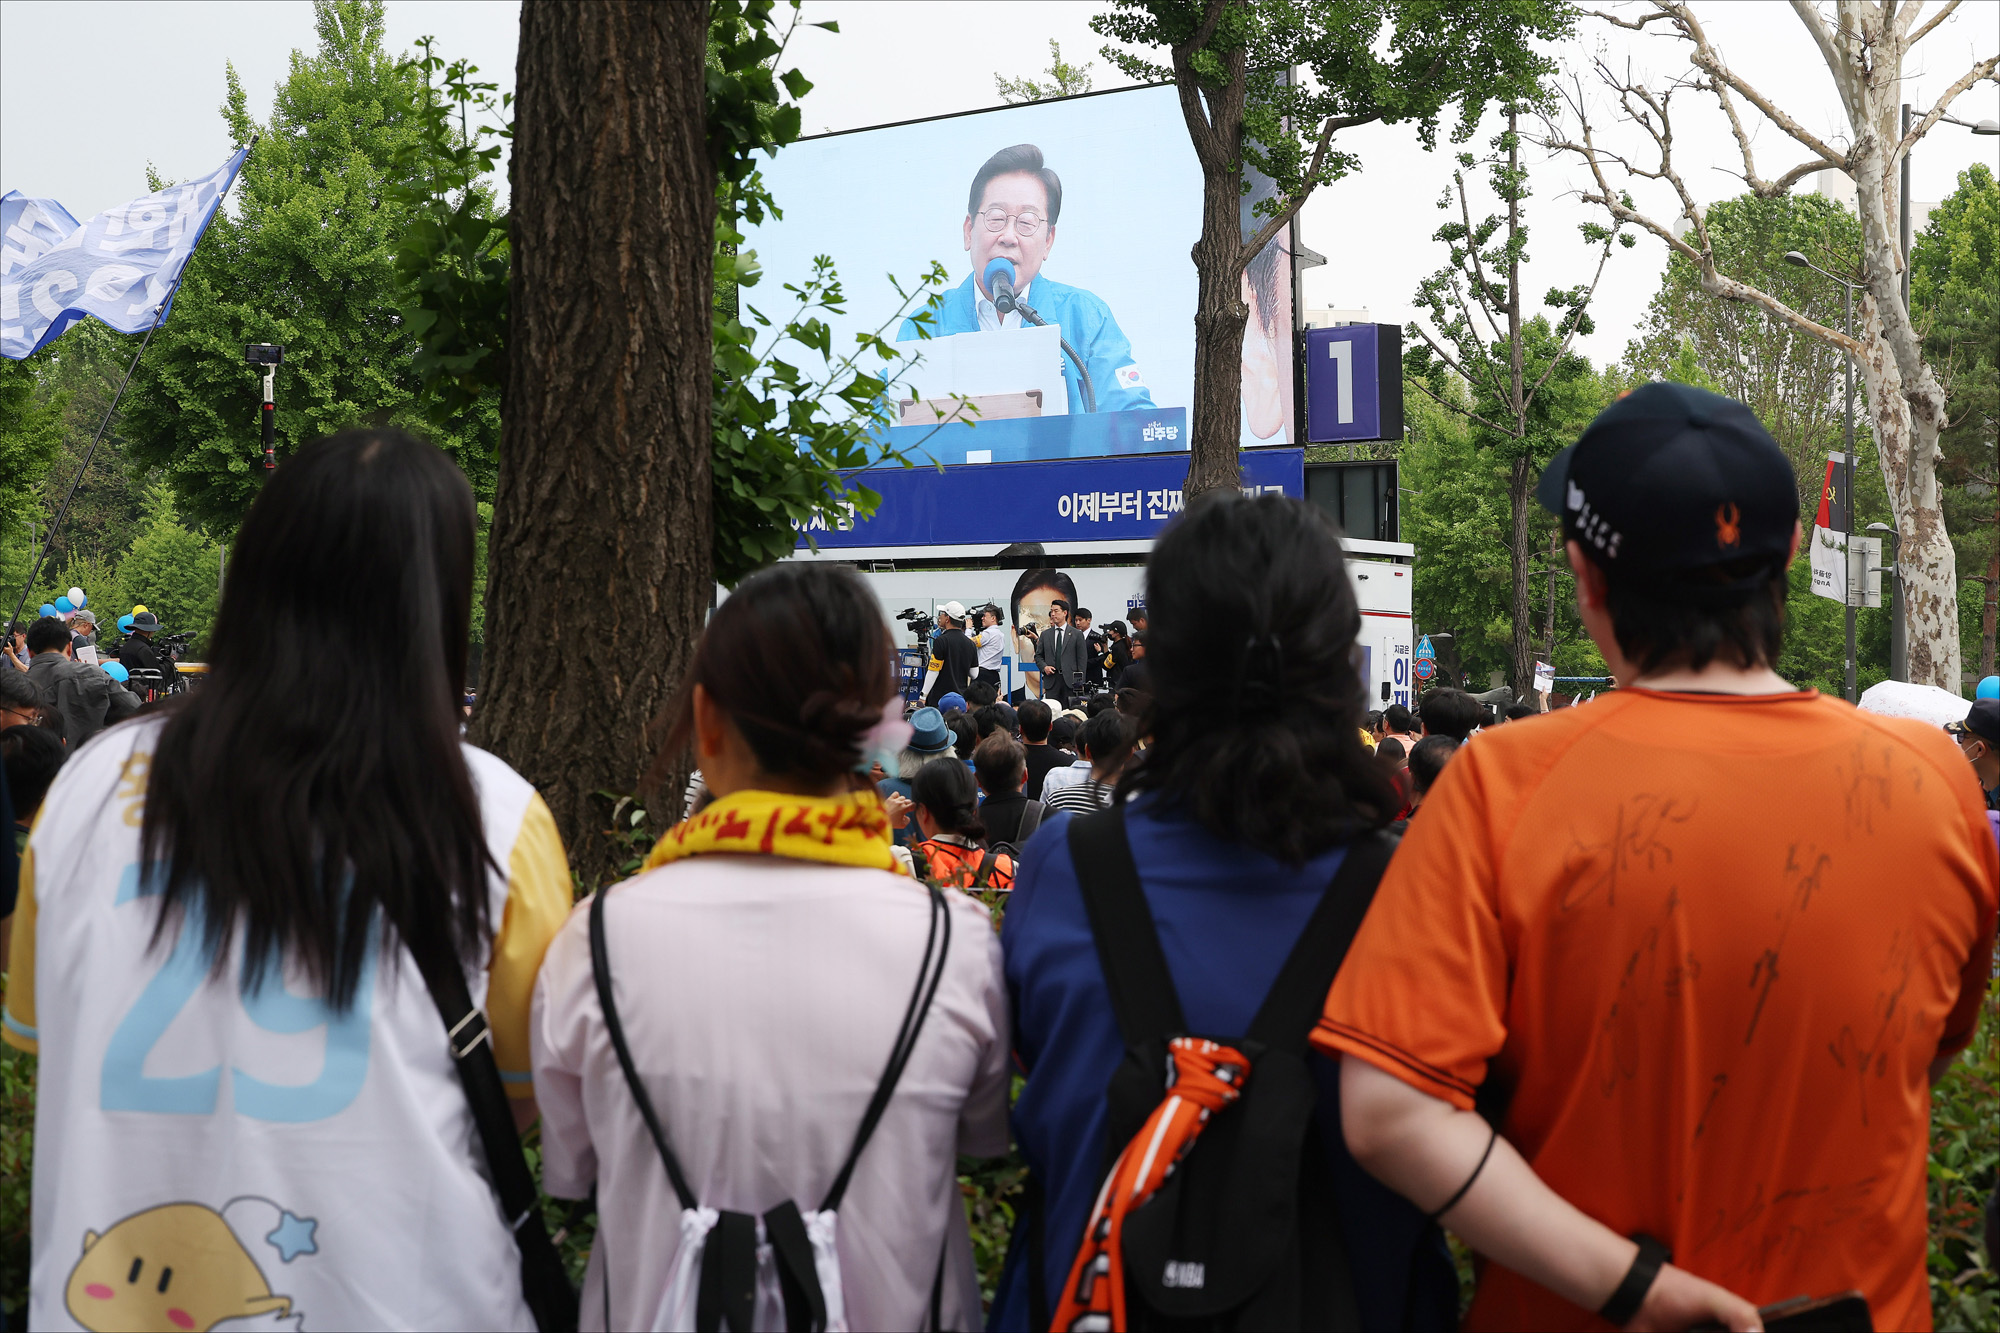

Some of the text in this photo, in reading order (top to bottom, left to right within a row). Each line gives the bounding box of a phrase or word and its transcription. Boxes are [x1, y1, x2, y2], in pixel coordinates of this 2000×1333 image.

[1329, 340, 1354, 424] 1
[1142, 426, 1179, 441] 민주당
[1057, 489, 1142, 523] 이제부터
[1394, 644, 1410, 655] 지금은
